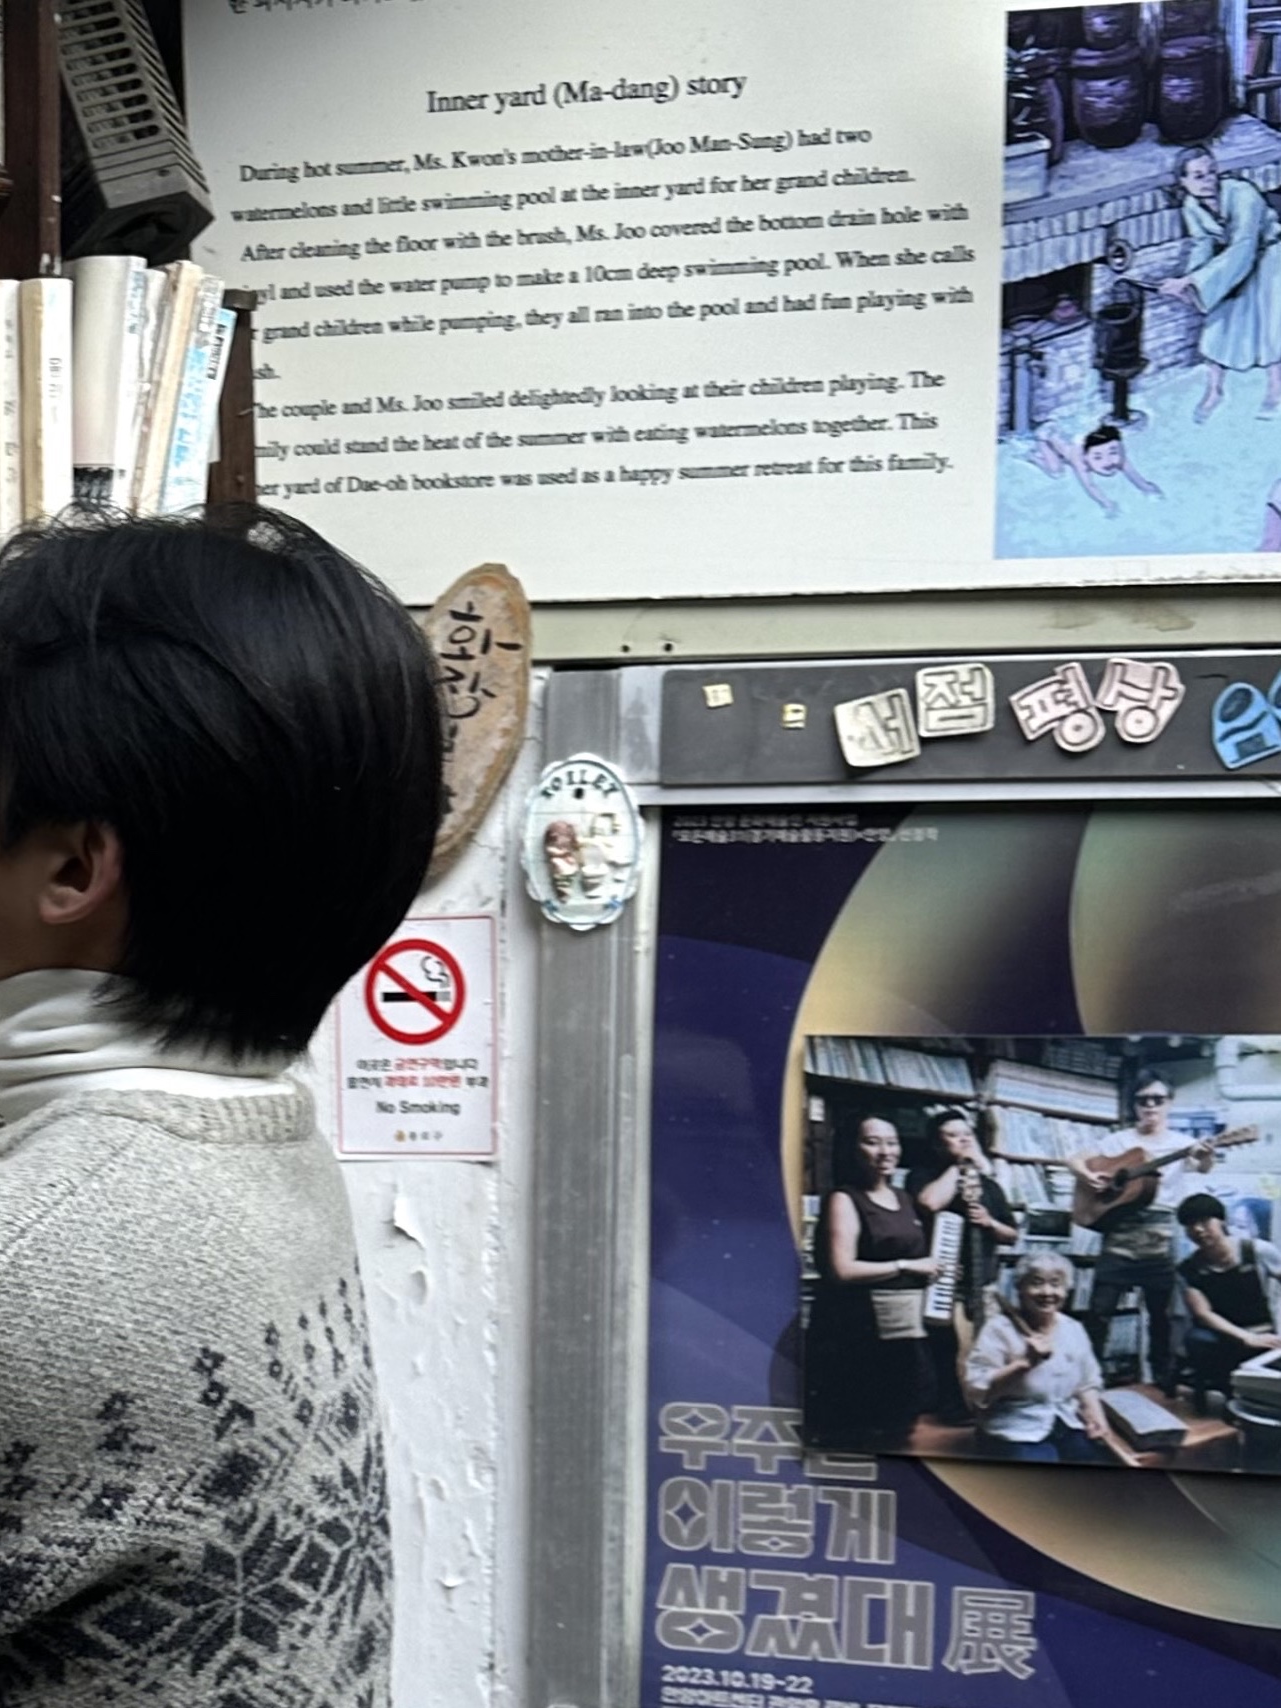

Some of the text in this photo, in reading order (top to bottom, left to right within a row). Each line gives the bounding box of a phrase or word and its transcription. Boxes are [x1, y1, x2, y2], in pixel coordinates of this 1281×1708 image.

[427, 75, 747, 114] Inner yard (Ma-dang) story
[240, 164, 299, 183] During
[304, 161, 331, 178] hot
[413, 153, 448, 171] Ms.
[452, 150, 517, 168] Kwon's
[797, 128, 831, 146] had
[835, 129, 872, 143] two
[231, 203, 338, 222] watermelons
[342, 198, 373, 216] and
[377, 196, 417, 214] little
[422, 191, 513, 212] swimming
[517, 187, 556, 210] pool
[560, 188, 578, 202] at
[582, 184, 609, 200] the
[613, 182, 659, 200] inner
[663, 177, 705, 201] yard
[709, 175, 738, 193] for
[740, 174, 772, 192] her
[774, 170, 828, 194] grand
[241, 202, 969, 262] After cleaning the floor with the brush, Ms. Joo covered the bottom drain hole with
[280, 282, 311, 300] and
[315, 280, 354, 297] used
[358, 277, 385, 295] the
[389, 276, 436, 293] water
[440, 275, 491, 295] pump
[495, 273, 513, 287] to
[516, 269, 564, 286] make
[568, 271, 579, 284] a
[584, 264, 633, 283] 10cm
[637, 262, 680, 282] deep
[683, 256, 779, 277] swimming
[835, 250, 891, 268] When
[895, 248, 928, 265] she
[931, 245, 976, 263] calls
[262, 321, 310, 344] grand
[314, 318, 383, 337] children
[388, 315, 435, 332] while
[525, 309, 563, 328] they
[567, 306, 590, 323] all
[594, 307, 623, 322] ran
[628, 303, 663, 320] into
[667, 301, 696, 318] the
[700, 298, 740, 321] pool
[744, 296, 778, 313] and
[782, 294, 816, 311] had
[821, 292, 852, 309] fun
[856, 289, 927, 313] playing
[931, 286, 974, 302] with
[281, 400, 338, 421] couple
[341, 398, 372, 415] and
[376, 397, 405, 413] Ms.
[412, 394, 444, 412] Joo
[447, 390, 504, 409] smiled
[610, 384, 678, 404] looking
[682, 385, 700, 399] at
[703, 380, 745, 397] their
[749, 377, 824, 395] children
[907, 370, 946, 388] The
[293, 438, 341, 456] could
[344, 436, 389, 454] stand
[392, 434, 419, 452] the
[423, 432, 460, 450] heat
[463, 432, 484, 448] of
[486, 430, 513, 447] the
[517, 429, 586, 447] summer
[591, 425, 630, 444] with
[634, 423, 690, 445] eating
[694, 419, 808, 438] watermelons
[895, 412, 939, 429] This
[283, 479, 321, 500] yard
[324, 477, 345, 494] of
[347, 475, 409, 493] Dae-oh
[412, 473, 496, 491] bookstore
[500, 472, 533, 487] was
[537, 468, 577, 486] used
[581, 470, 600, 483] as
[604, 470, 615, 482] a
[619, 466, 674, 486] happy
[678, 463, 749, 479] summer
[753, 460, 813, 477] retreat
[817, 457, 845, 474] for
[849, 455, 883, 472] this
[1012, 662, 1186, 752] 평상
[541, 769, 620, 799] TOILET
[376, 1100, 461, 1116] No Smoking
[658, 1476, 897, 1565] 이렇게
[655, 1563, 1038, 1680] 생겼대 展
